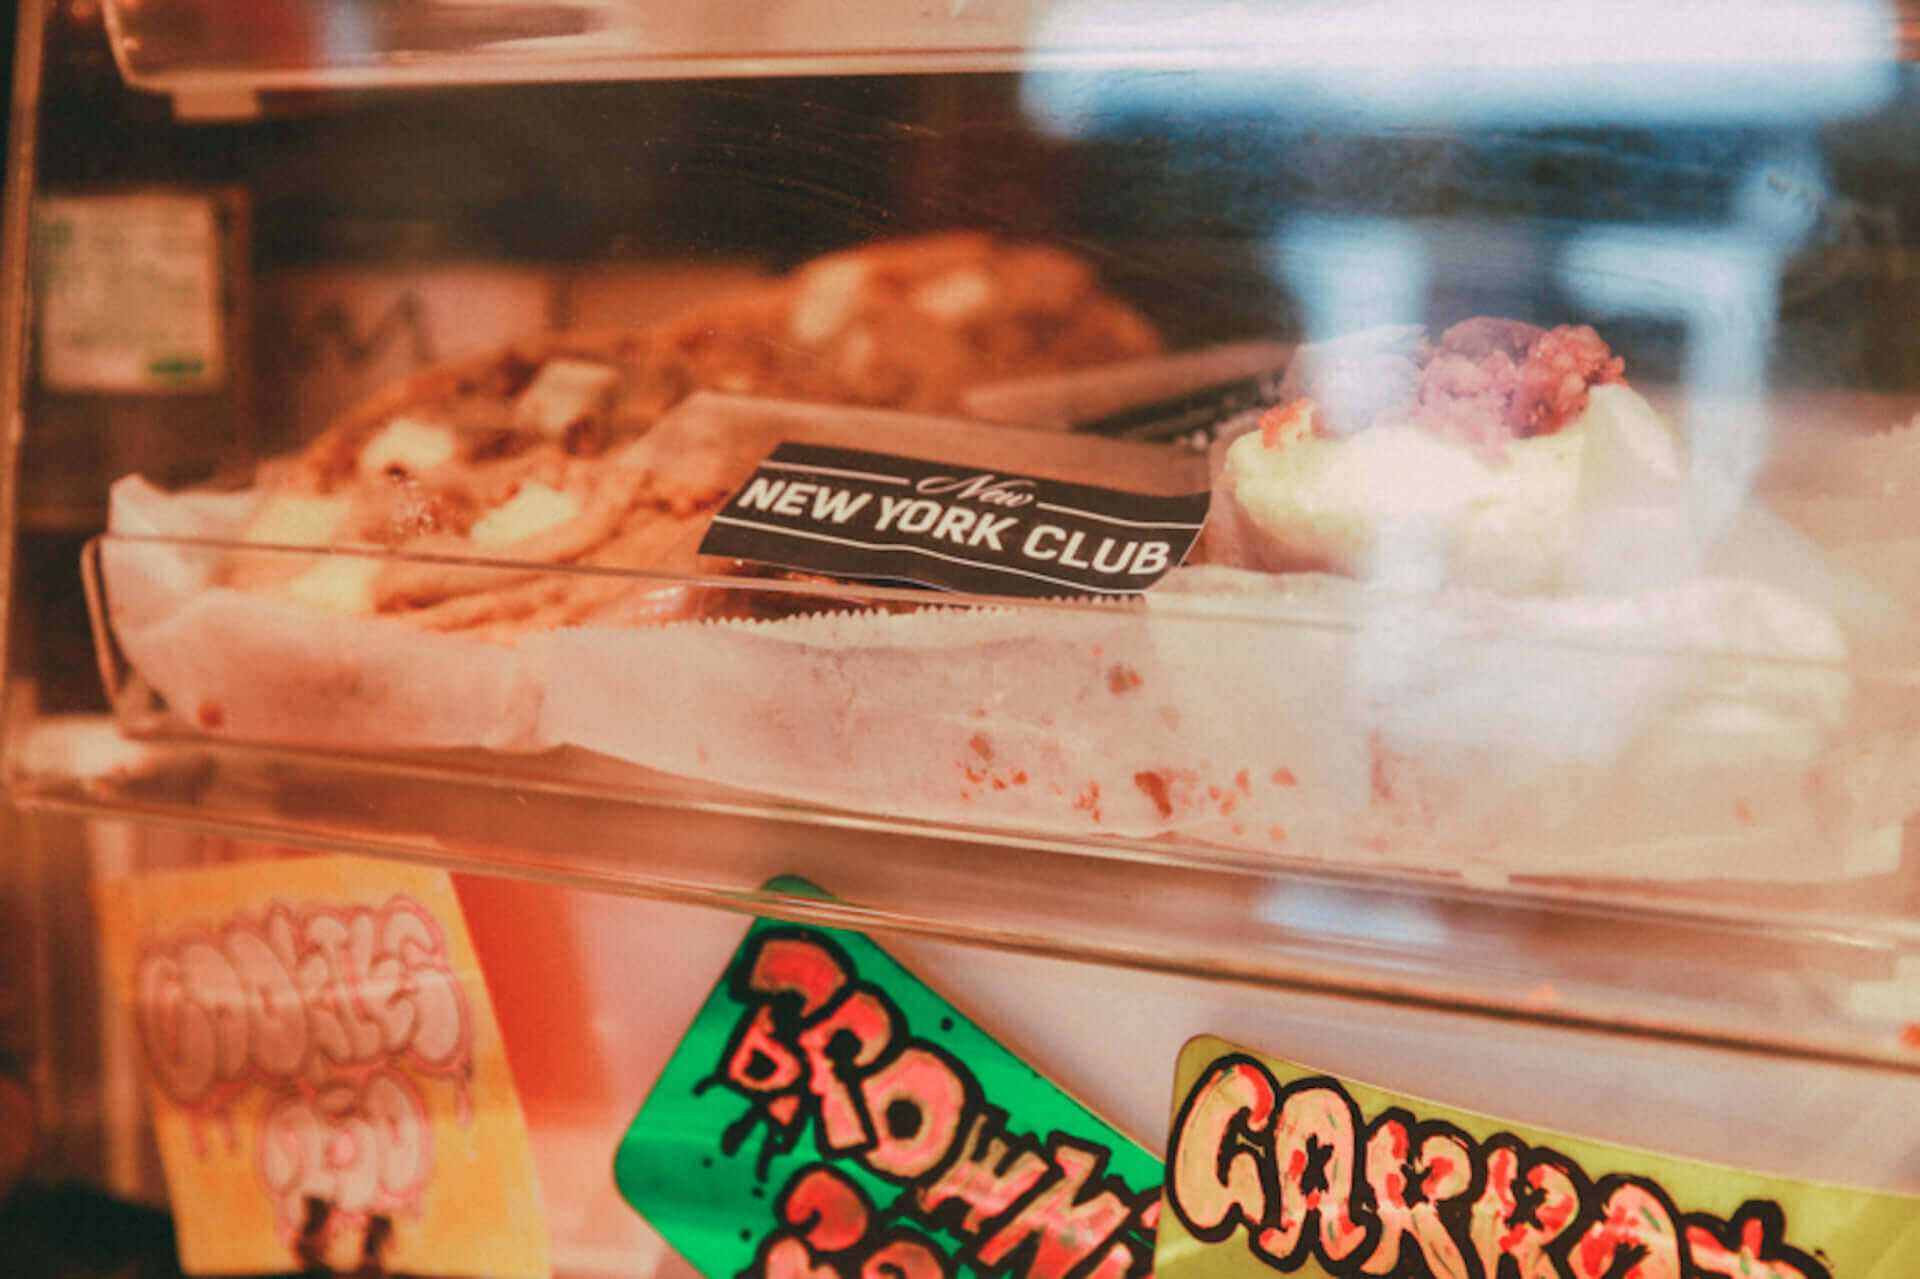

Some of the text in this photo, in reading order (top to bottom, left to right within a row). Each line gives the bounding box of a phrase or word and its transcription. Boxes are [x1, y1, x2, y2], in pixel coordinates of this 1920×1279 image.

[915, 473, 1036, 508] New
[737, 477, 1170, 577] NEW YORK CLUB
